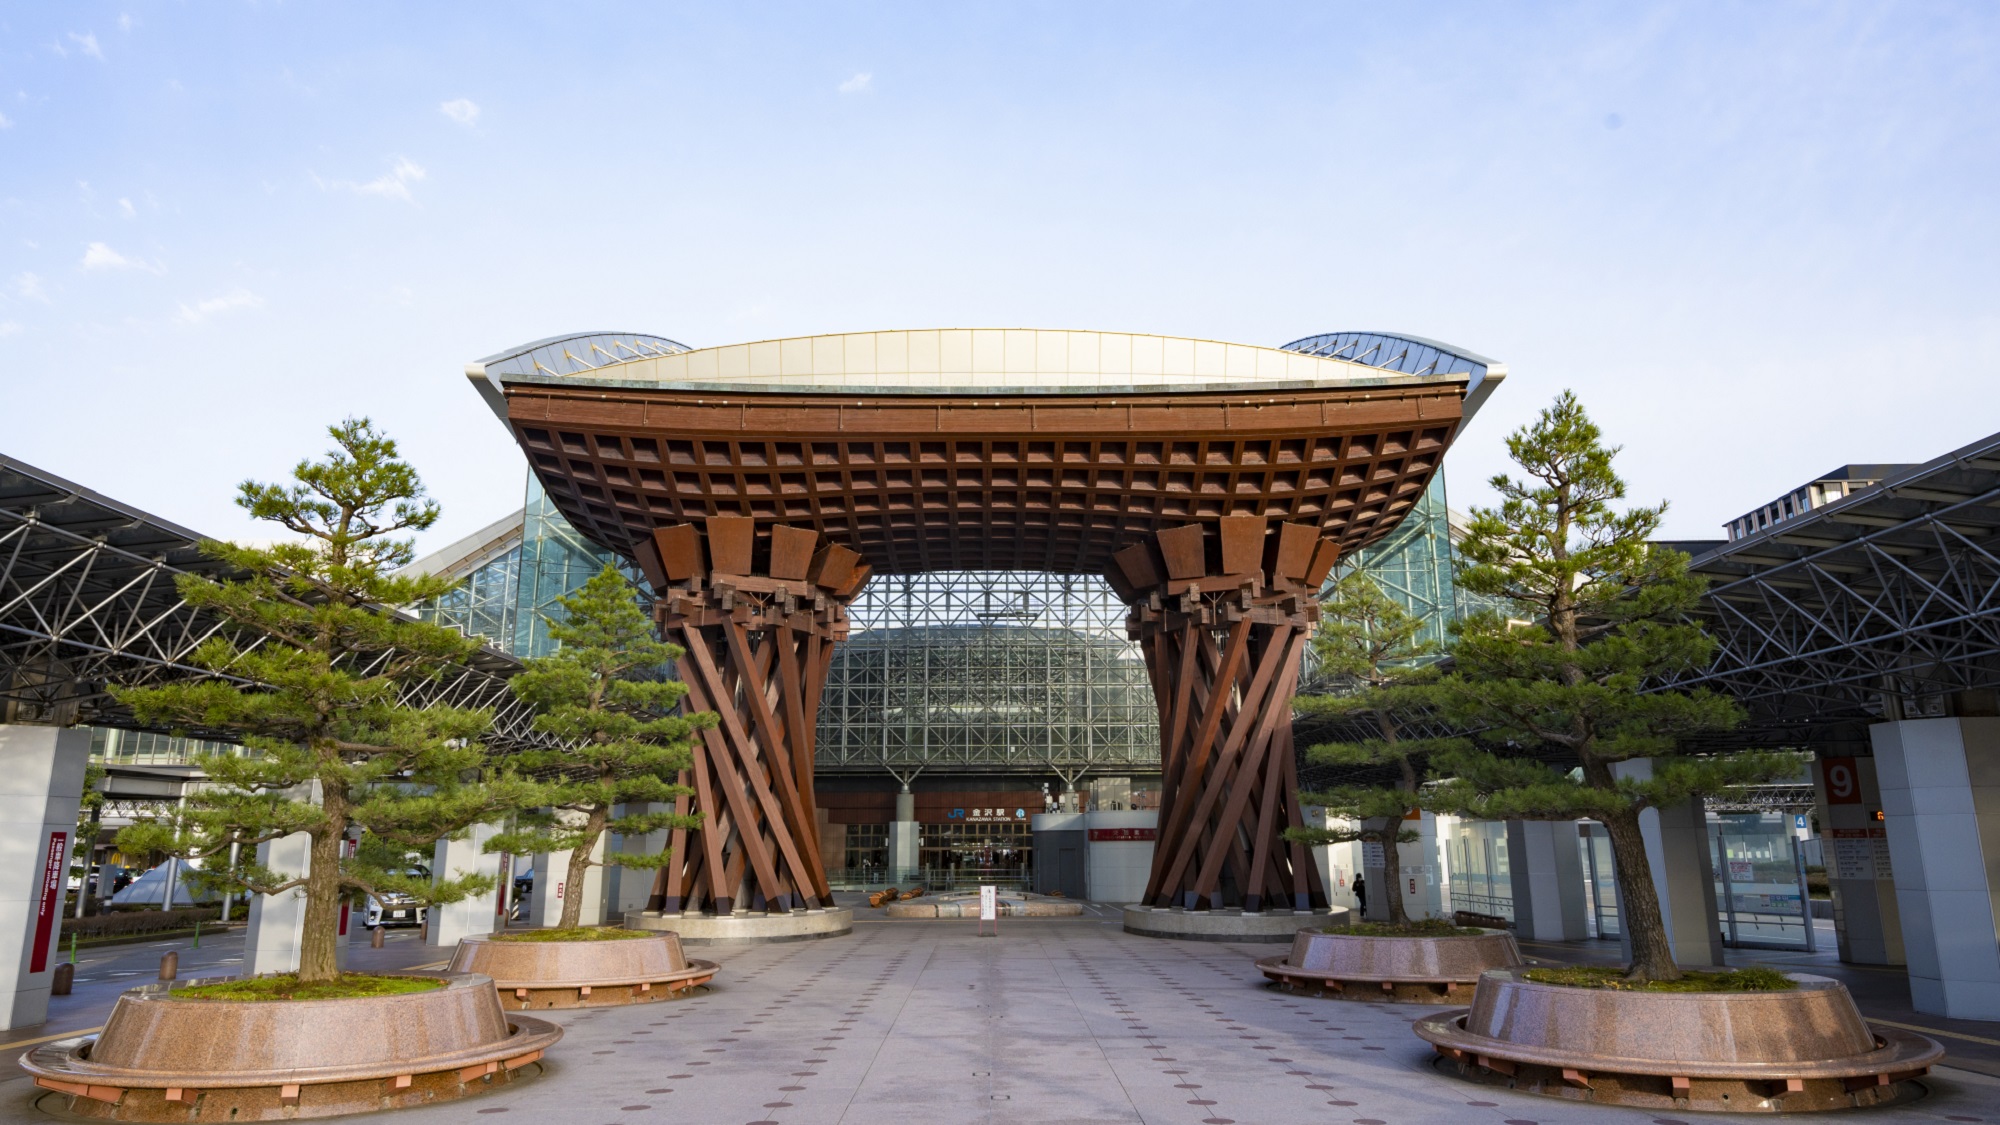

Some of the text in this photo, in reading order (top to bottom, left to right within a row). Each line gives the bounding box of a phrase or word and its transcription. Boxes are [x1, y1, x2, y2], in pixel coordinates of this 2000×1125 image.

[1830, 765, 1853, 797] 9
[948, 808, 964, 819] JR
[972, 808, 1005, 817] 金沢駅
[1797, 816, 1804, 826] 4
[48, 838, 57, 869] Passenger
